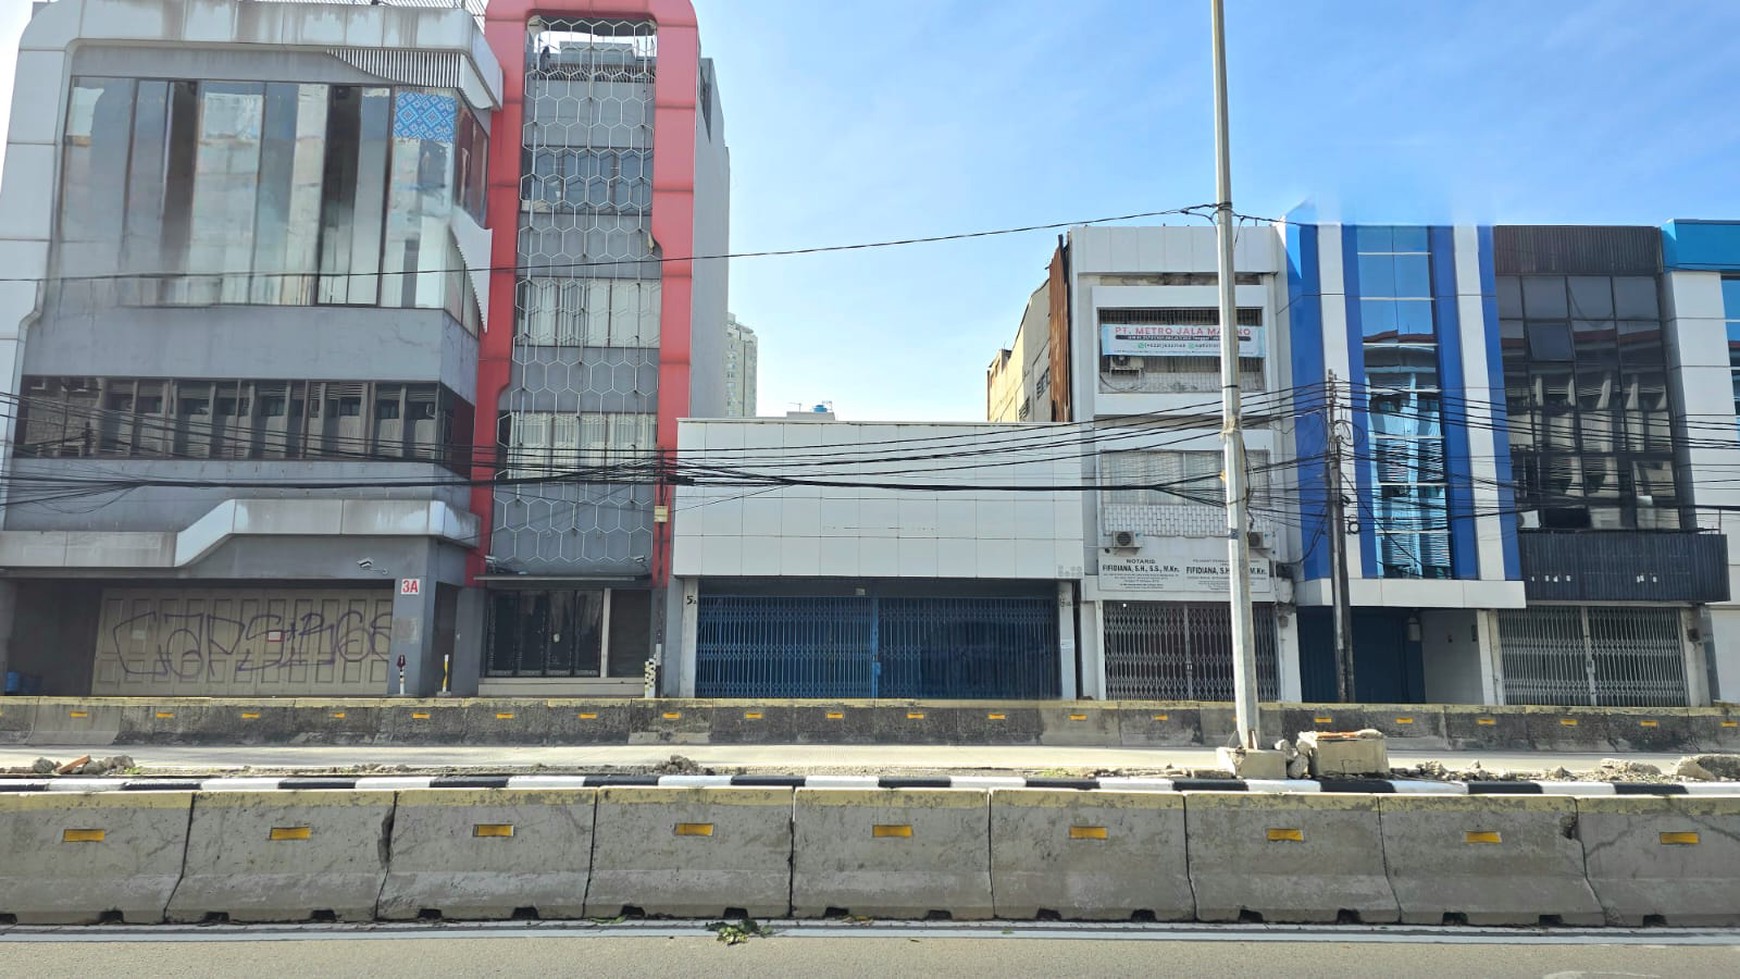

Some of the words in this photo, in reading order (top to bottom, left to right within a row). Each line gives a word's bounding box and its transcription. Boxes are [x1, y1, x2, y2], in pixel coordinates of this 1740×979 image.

[1115, 327, 1131, 335] PT.
[1135, 327, 1173, 335] METRO
[1176, 327, 1203, 335] JALA
[403, 580, 419, 593] 3A
